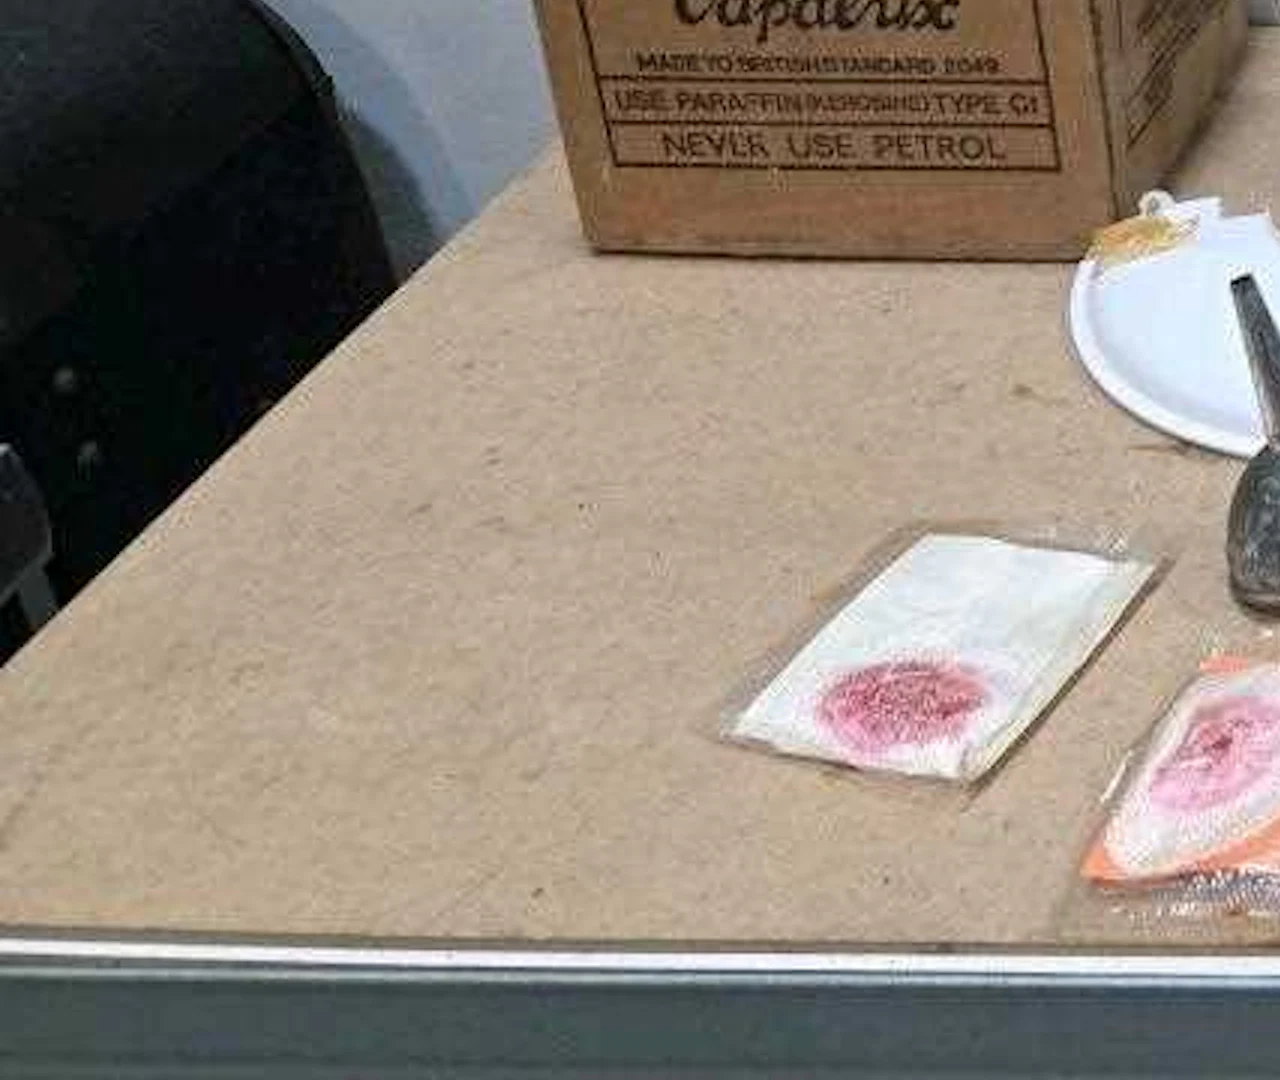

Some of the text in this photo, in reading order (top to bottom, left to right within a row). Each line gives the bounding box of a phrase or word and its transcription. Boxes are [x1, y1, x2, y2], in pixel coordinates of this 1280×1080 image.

[637, 53, 698, 72] MADE
[700, 54, 731, 72] TO
[615, 89, 674, 111] USE
[676, 91, 804, 113] PARAFFIN
[931, 92, 1001, 115] TYPE
[662, 131, 1006, 161] NEVER USE PETROL
